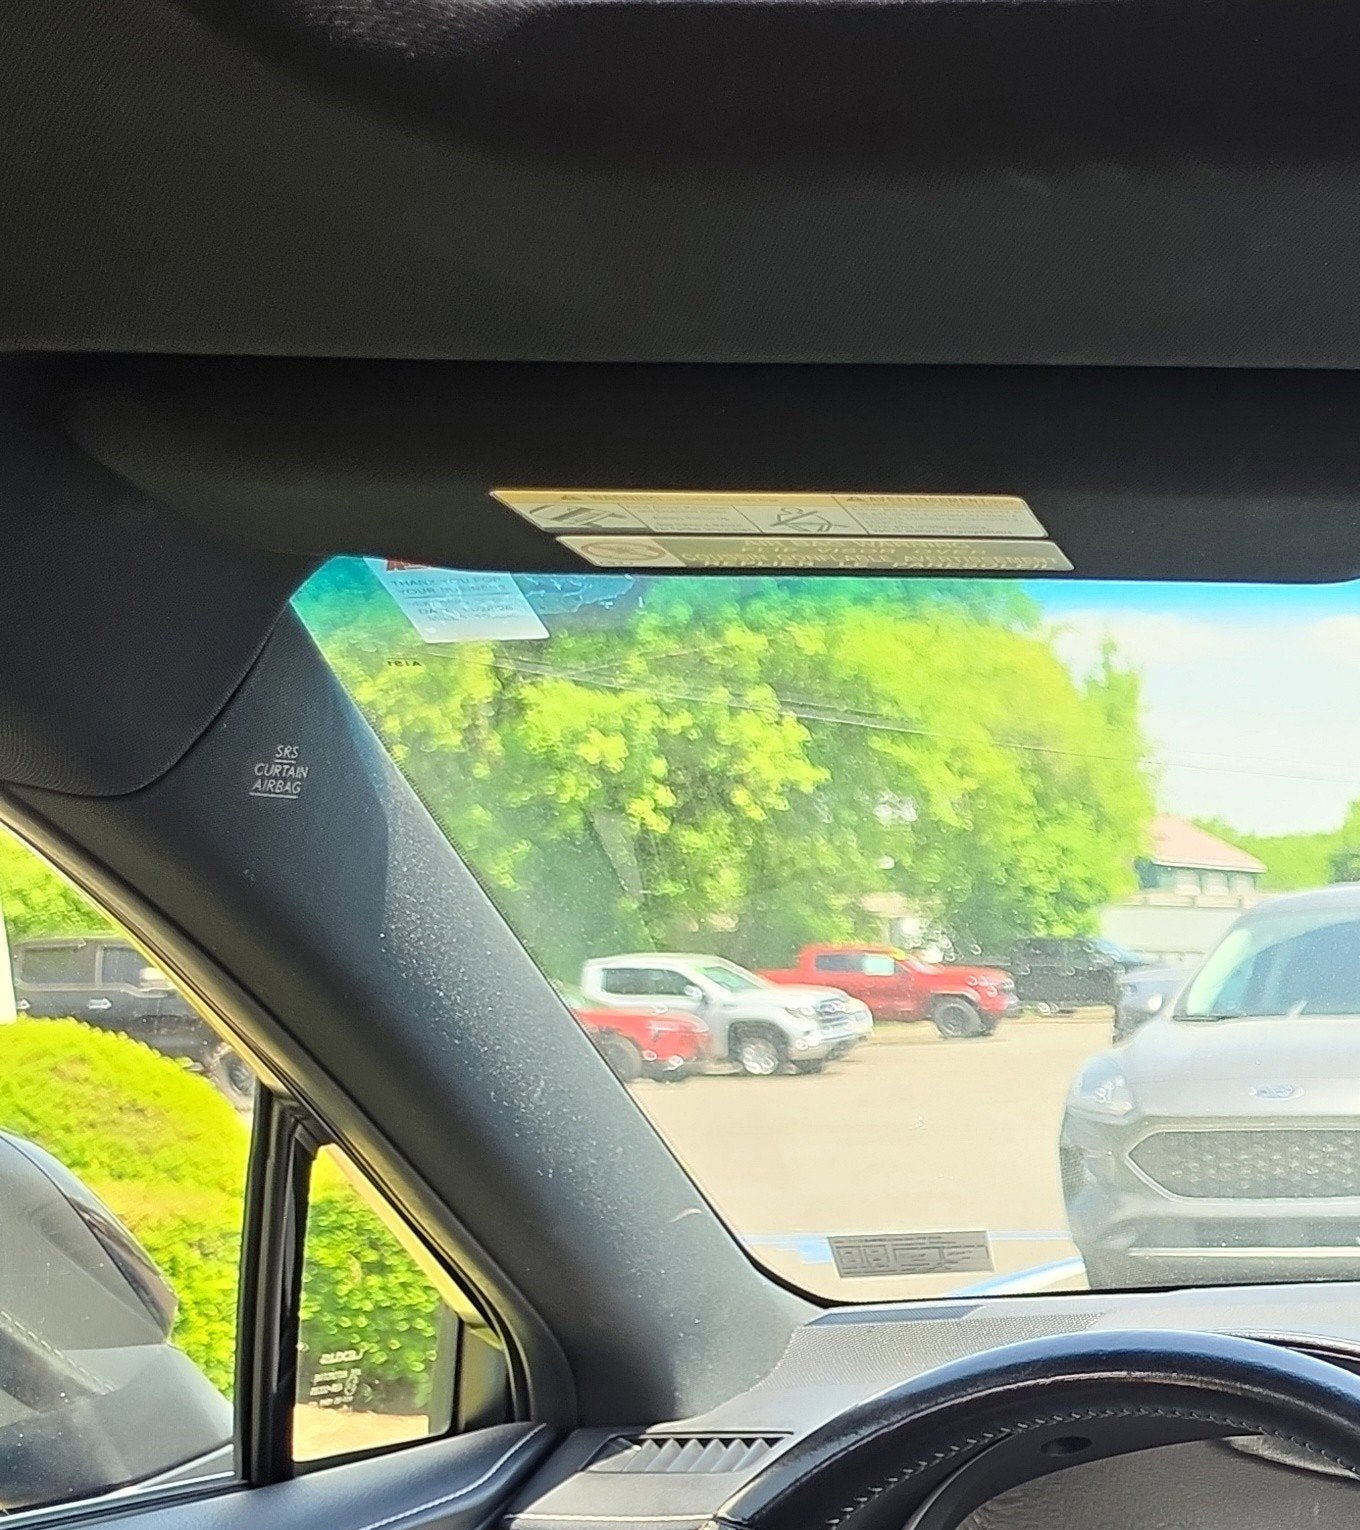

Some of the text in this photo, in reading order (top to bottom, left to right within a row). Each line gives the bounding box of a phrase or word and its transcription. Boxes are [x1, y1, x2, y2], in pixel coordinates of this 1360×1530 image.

[275, 744, 299, 758] SRS
[254, 763, 308, 778] CURTAIN
[251, 779, 301, 794] AIRBAG
